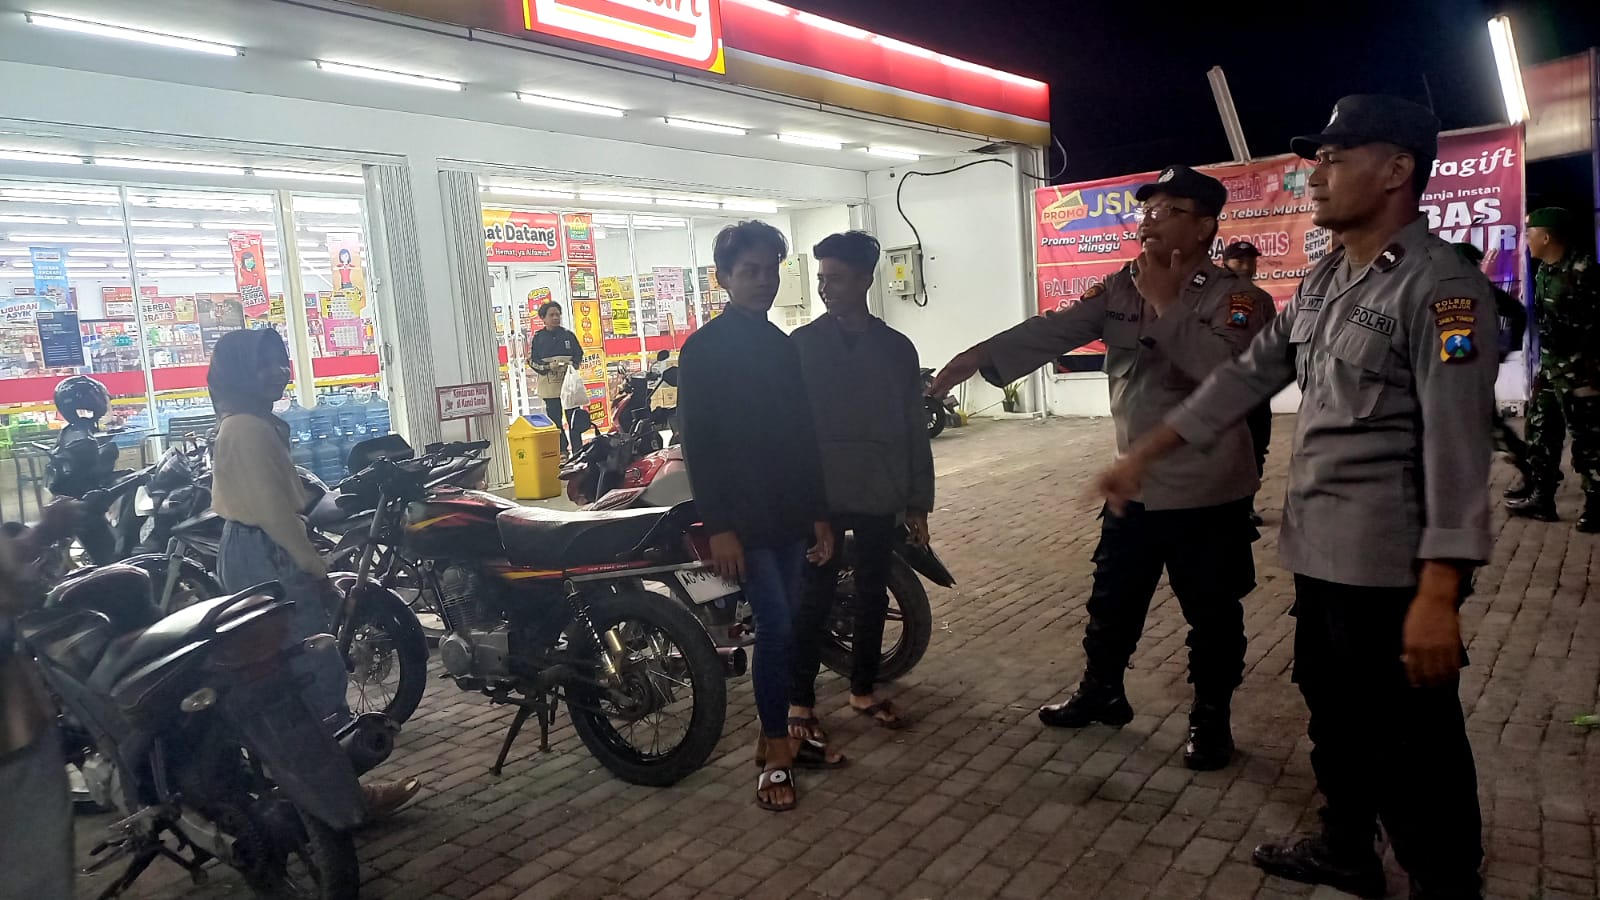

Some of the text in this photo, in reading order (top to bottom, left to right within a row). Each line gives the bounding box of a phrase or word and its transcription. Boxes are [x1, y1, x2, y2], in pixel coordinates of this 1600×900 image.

[1458, 186, 1501, 197] Instan
[1043, 208, 1084, 220] PROMO
[1231, 208, 1269, 219] Tebus
[1273, 203, 1315, 215] Murah
[505, 223, 555, 247] Datang
[1041, 237, 1076, 246] Promo
[1079, 232, 1119, 243] Jum'at,
[1078, 242, 1120, 253] Minggu
[1304, 236, 1330, 251] SETIAP
[1351, 308, 1392, 332] POLRI
